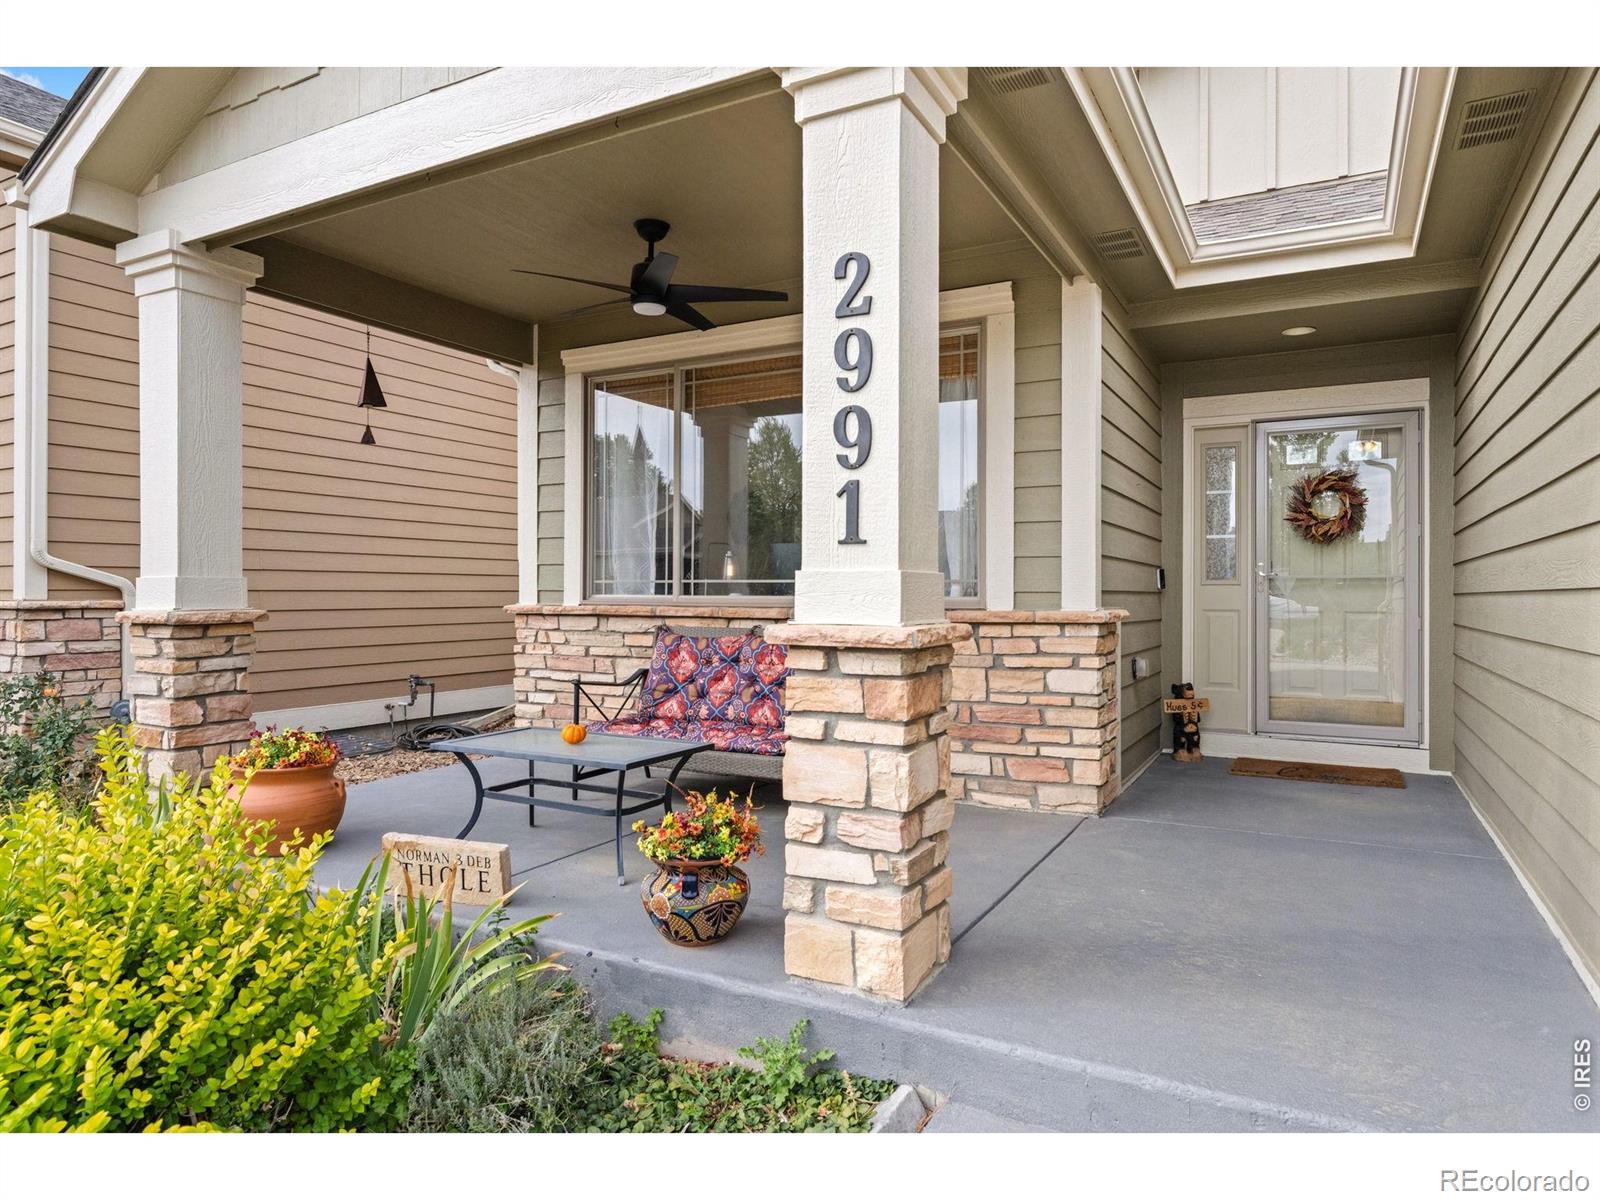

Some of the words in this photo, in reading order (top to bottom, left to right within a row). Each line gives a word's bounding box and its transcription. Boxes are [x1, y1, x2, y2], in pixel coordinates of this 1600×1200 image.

[834, 252, 873, 544] 2991
[397, 848, 450, 864] NORMAN
[467, 855, 491, 869] DEB
